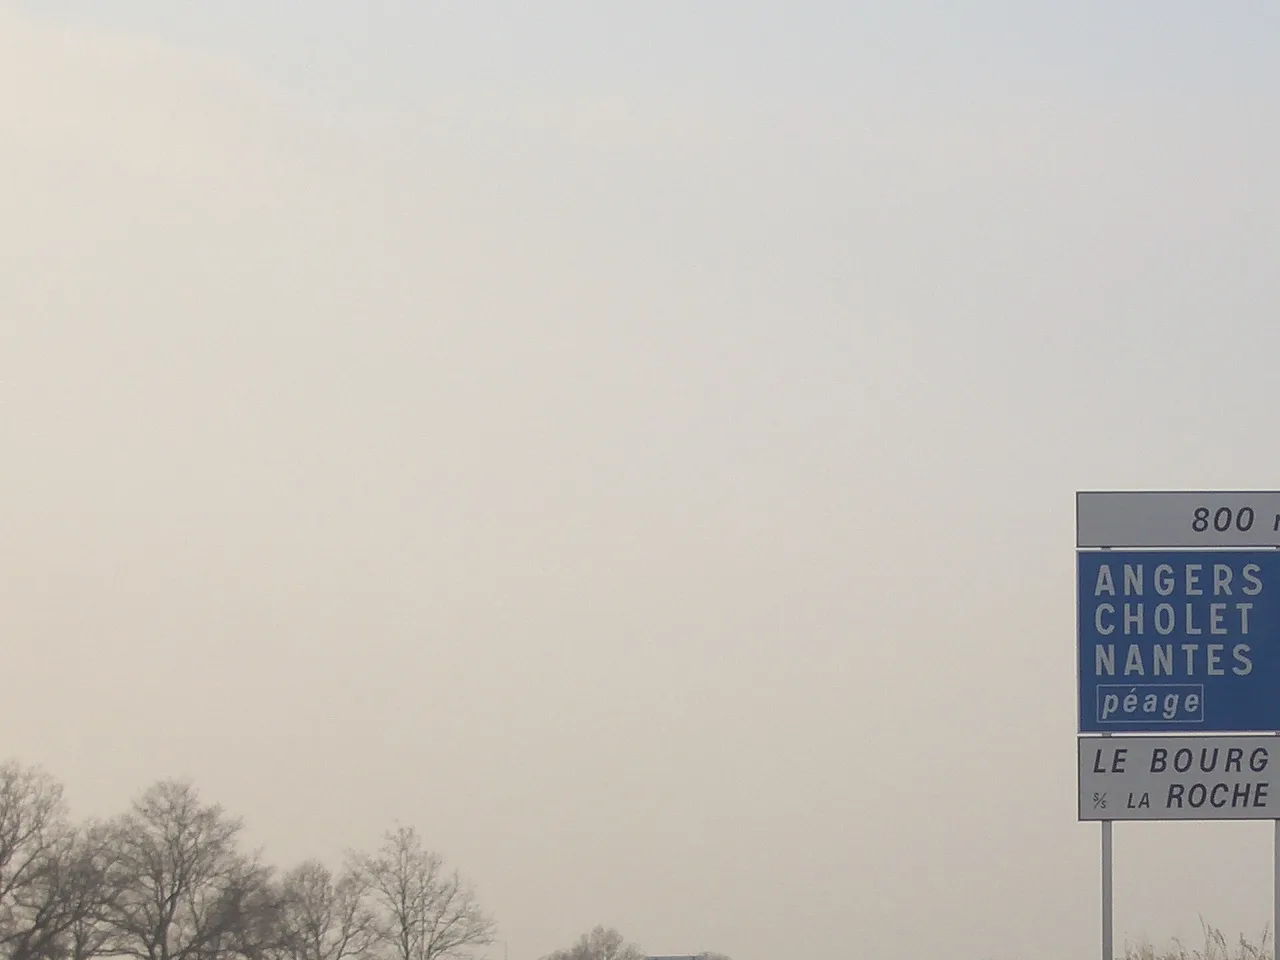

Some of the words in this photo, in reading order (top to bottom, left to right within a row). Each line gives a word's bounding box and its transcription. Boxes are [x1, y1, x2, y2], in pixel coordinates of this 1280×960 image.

[1192, 506, 1255, 532] 800
[1094, 563, 1263, 596] ANGERS
[1095, 602, 1254, 635] CHOLET
[1095, 644, 1254, 676] NANTES
[1102, 687, 1200, 719] péage
[1093, 748, 1128, 773] LE
[1150, 748, 1270, 773] BOURG
[1127, 792, 1150, 809] LA
[1166, 782, 1270, 808] ROCHE
